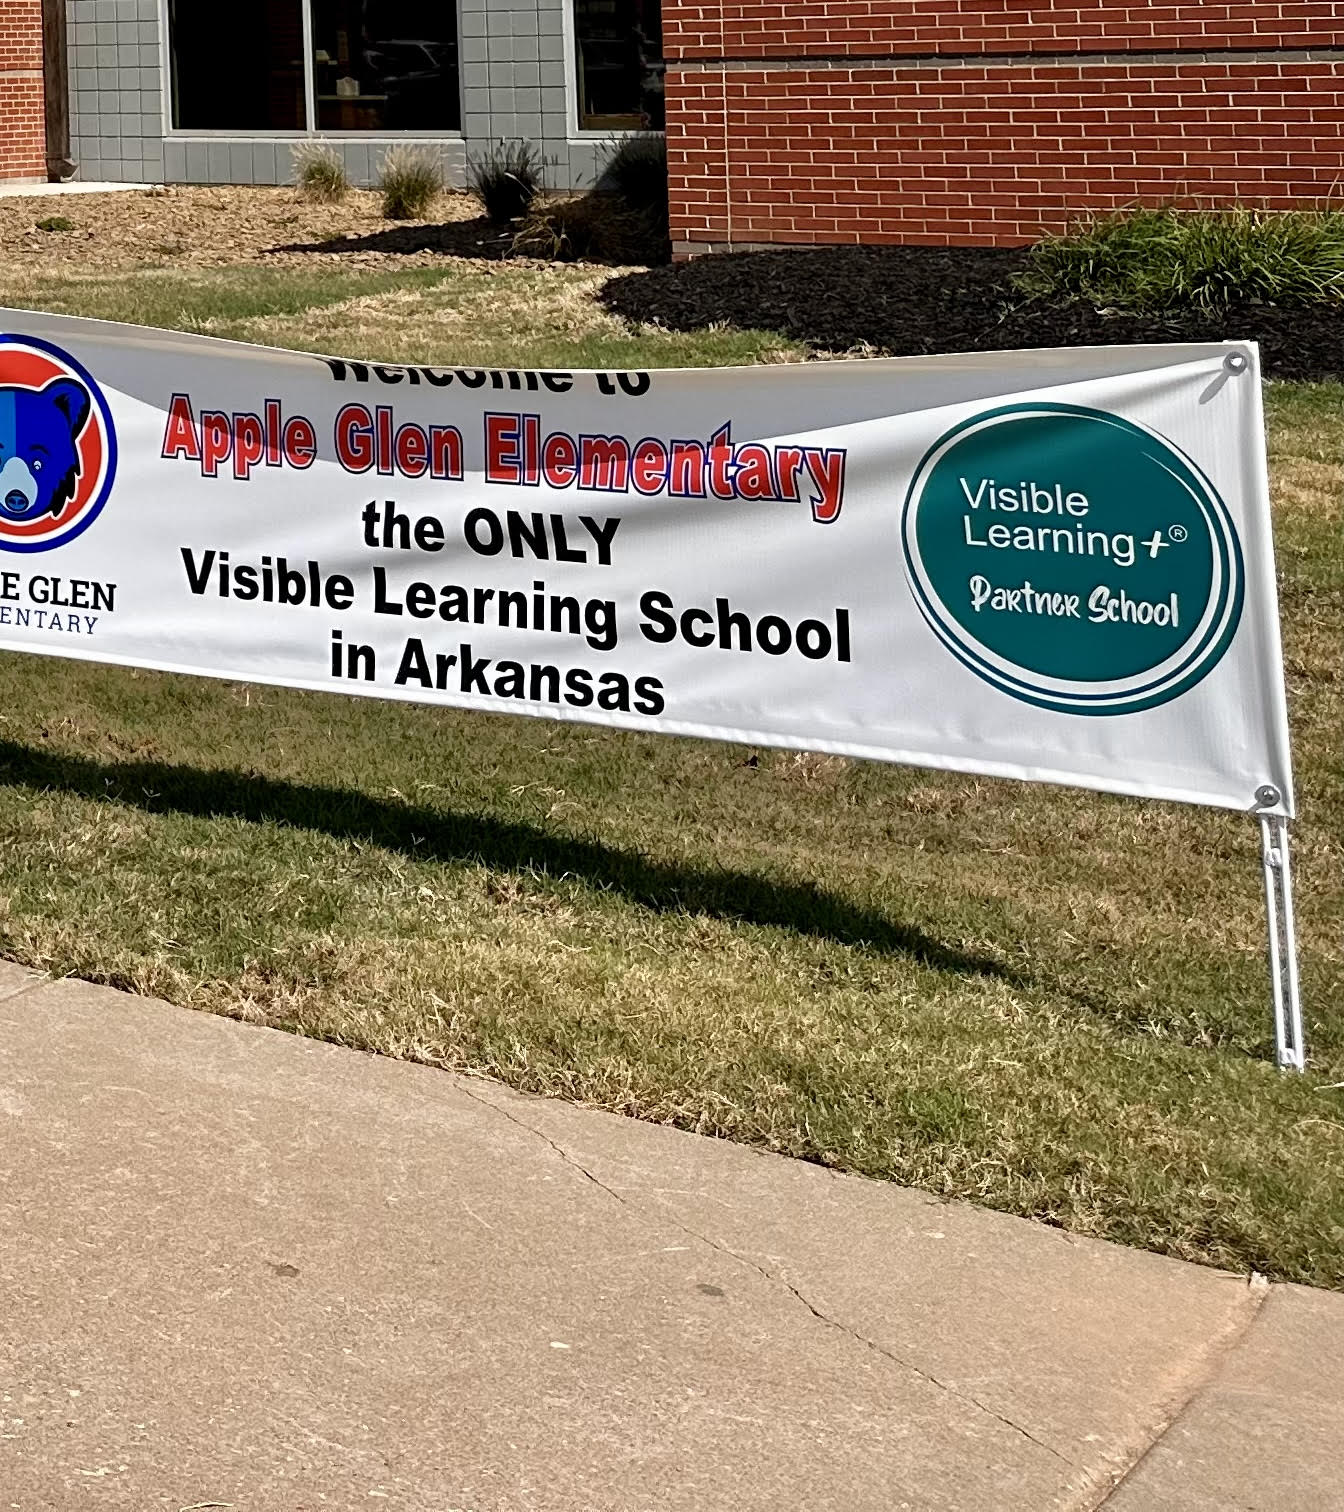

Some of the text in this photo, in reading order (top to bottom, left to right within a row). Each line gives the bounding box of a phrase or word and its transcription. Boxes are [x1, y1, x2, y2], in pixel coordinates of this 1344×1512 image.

[161, 392, 847, 525] Apple Glen Elementary
[959, 477, 1089, 517] Visible
[361, 500, 622, 566] the ONLY
[28, 575, 118, 612] GLEN
[180, 547, 852, 663] Visible Learning School
[1087, 585, 1180, 628] School
[331, 629, 666, 716] in Arkansas
